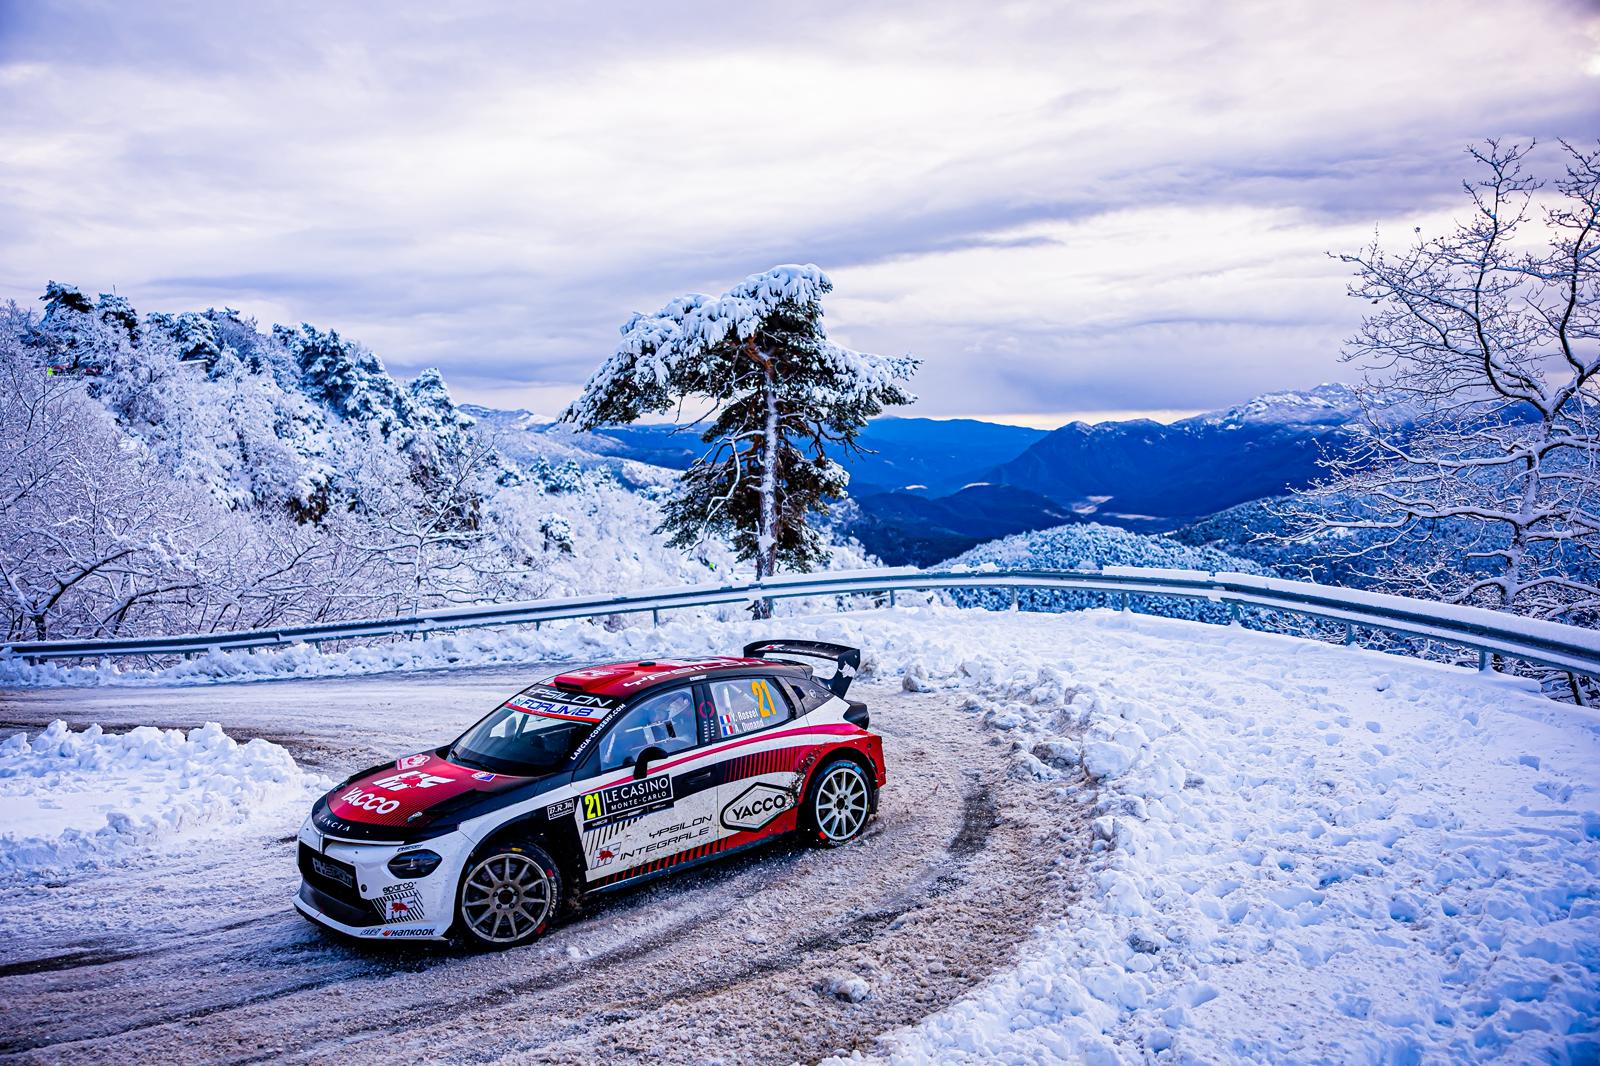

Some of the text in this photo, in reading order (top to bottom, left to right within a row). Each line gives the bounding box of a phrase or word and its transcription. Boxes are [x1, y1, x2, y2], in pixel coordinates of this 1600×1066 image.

[521, 699, 595, 717] FORUM8
[527, 687, 614, 708] YPSILON
[751, 679, 777, 717] 21
[738, 708, 759, 721] Rossel
[569, 703, 627, 761] LANCIA-CORSEHF.COM
[341, 786, 400, 815] YACCO
[605, 777, 669, 804] LE CASINO
[611, 791, 667, 811] MONTE-CARLO
[584, 792, 602, 820] 21
[732, 794, 786, 820] YACCO
[318, 814, 351, 832] LANCIA
[648, 813, 713, 839] YPSILON
[619, 826, 710, 861] INTEGRALE
